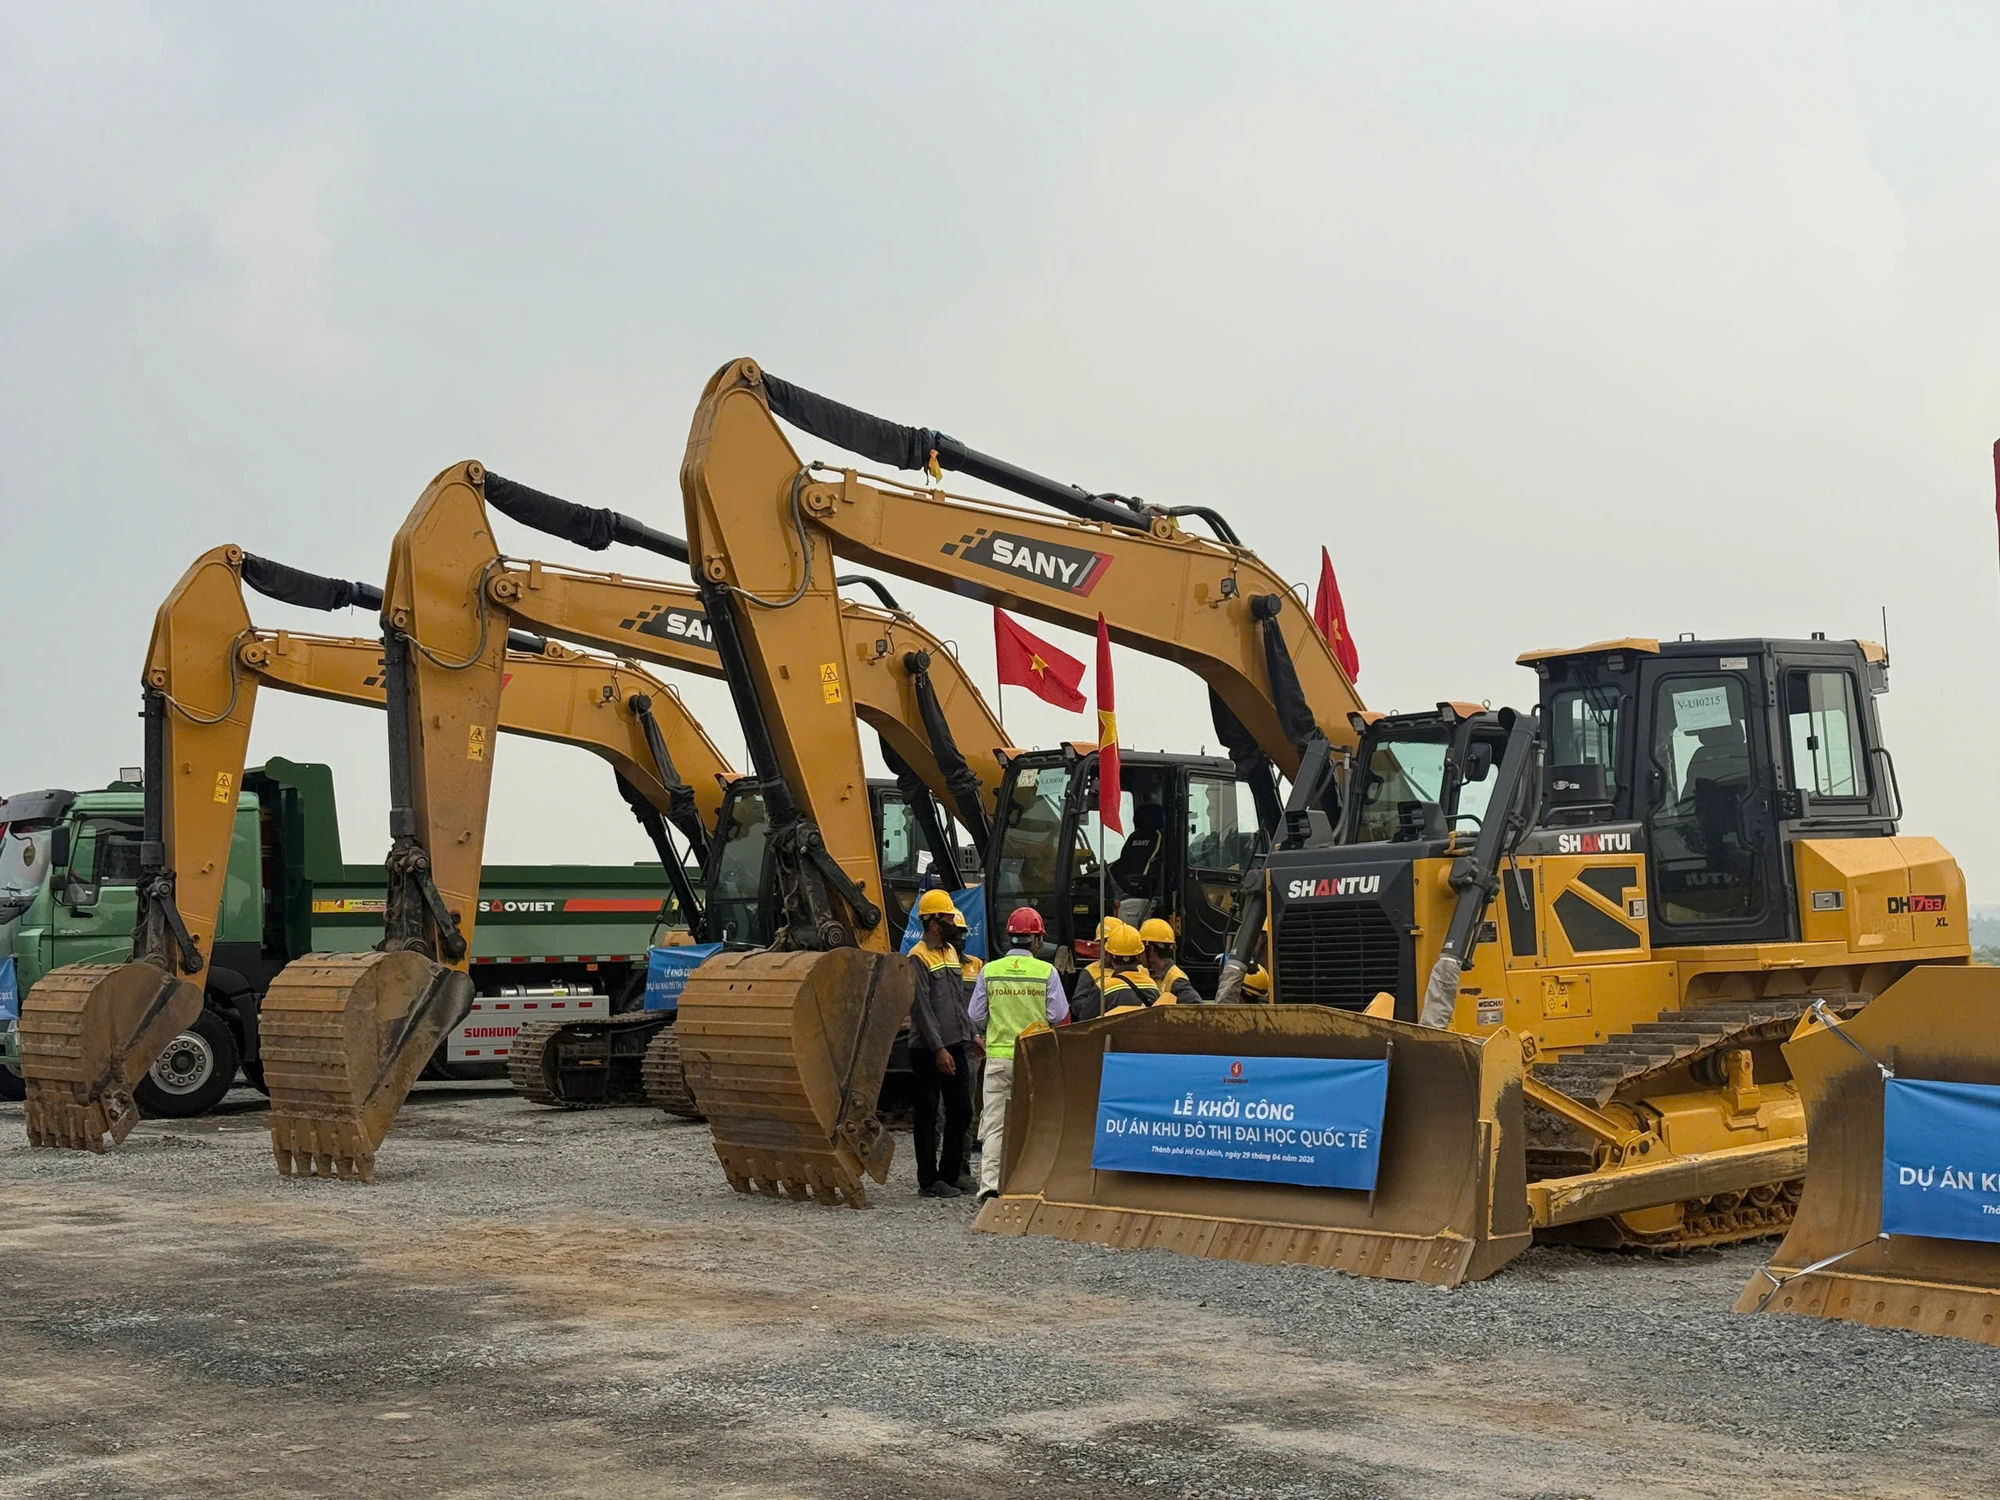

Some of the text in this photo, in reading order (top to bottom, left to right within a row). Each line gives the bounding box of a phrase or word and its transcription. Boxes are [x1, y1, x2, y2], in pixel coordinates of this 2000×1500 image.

[992, 538, 1078, 584] SANY
[667, 613, 713, 643] SA
[1558, 833, 1631, 853] SHANTUI
[1288, 875, 1380, 899] SHANTUI
[1935, 917, 1948, 927] XL
[1173, 1092, 1295, 1121] LỄ KHỞI CÔNG
[1106, 1117, 1369, 1149] DỰ ÁN KHU ĐÔ THỊ ĐẠI HỌC QUỐC TẾ
[1151, 1145, 1171, 1154] Thành
[1242, 1151, 1250, 1159] 29
[1272, 1153, 1281, 1162] 04
[1900, 1165, 2000, 1191] DỰ ÁN K
